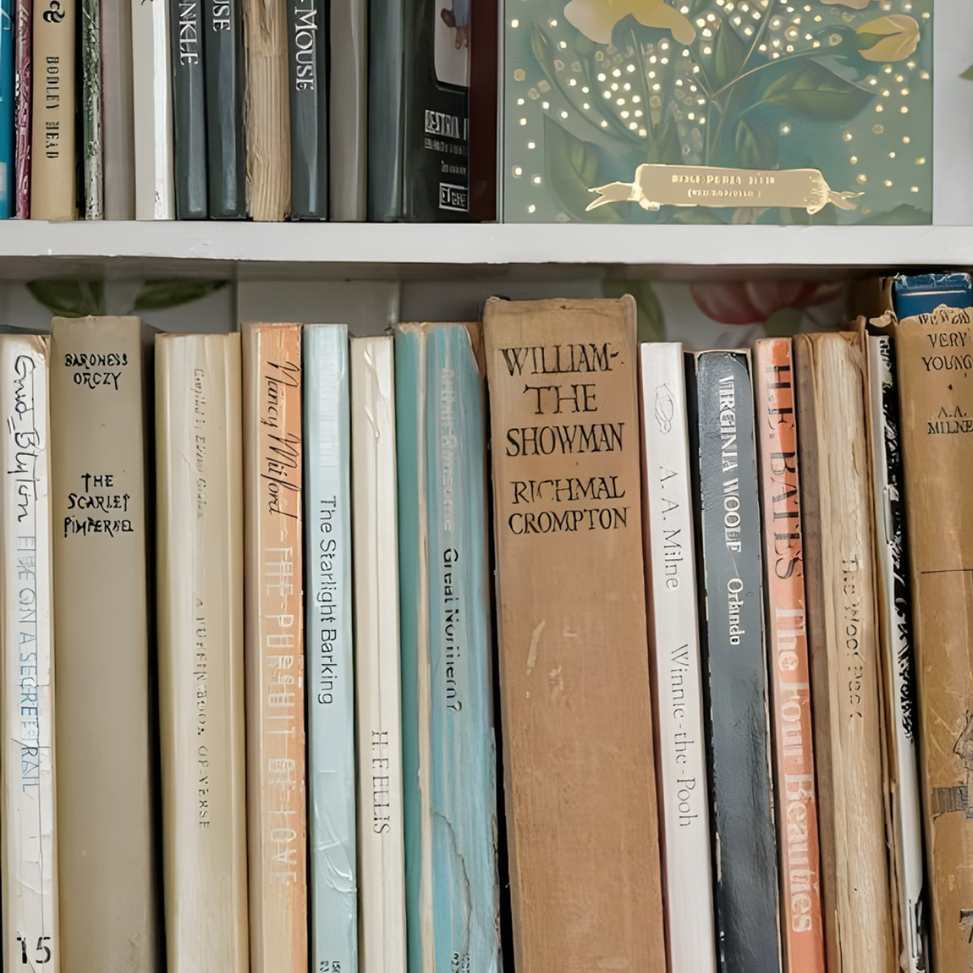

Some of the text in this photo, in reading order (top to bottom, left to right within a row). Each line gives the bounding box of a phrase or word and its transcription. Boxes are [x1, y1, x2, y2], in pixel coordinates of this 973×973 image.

[928, 332, 967, 348] VERY
[64, 353, 128, 370] BARONESS
[921, 354, 973, 372] YOUNG
[73, 372, 122, 390] ORCZY
[522, 383, 599, 415] THE
[7, 355, 41, 523] Enid Blyton
[260, 361, 301, 520] Nancy Mitford
[505, 422, 626, 457] SHOWMAN
[718, 375, 739, 474] VIRGINIA
[81, 473, 114, 493] THE
[510, 475, 626, 505] RICHMAL
[67, 492, 130, 514] SCARLET
[722, 478, 742, 553] WOOLF
[769, 452, 804, 581] BATES
[508, 506, 631, 535] CROMPTON
[264, 547, 294, 596] THE
[663, 528, 684, 591] Milne
[316, 495, 338, 705] The Starlight Barking
[19, 631, 37, 644] A
[775, 607, 817, 933] The Four Beauties
[373, 775, 391, 835] ELLIS
[16, 936, 51, 964] 15
